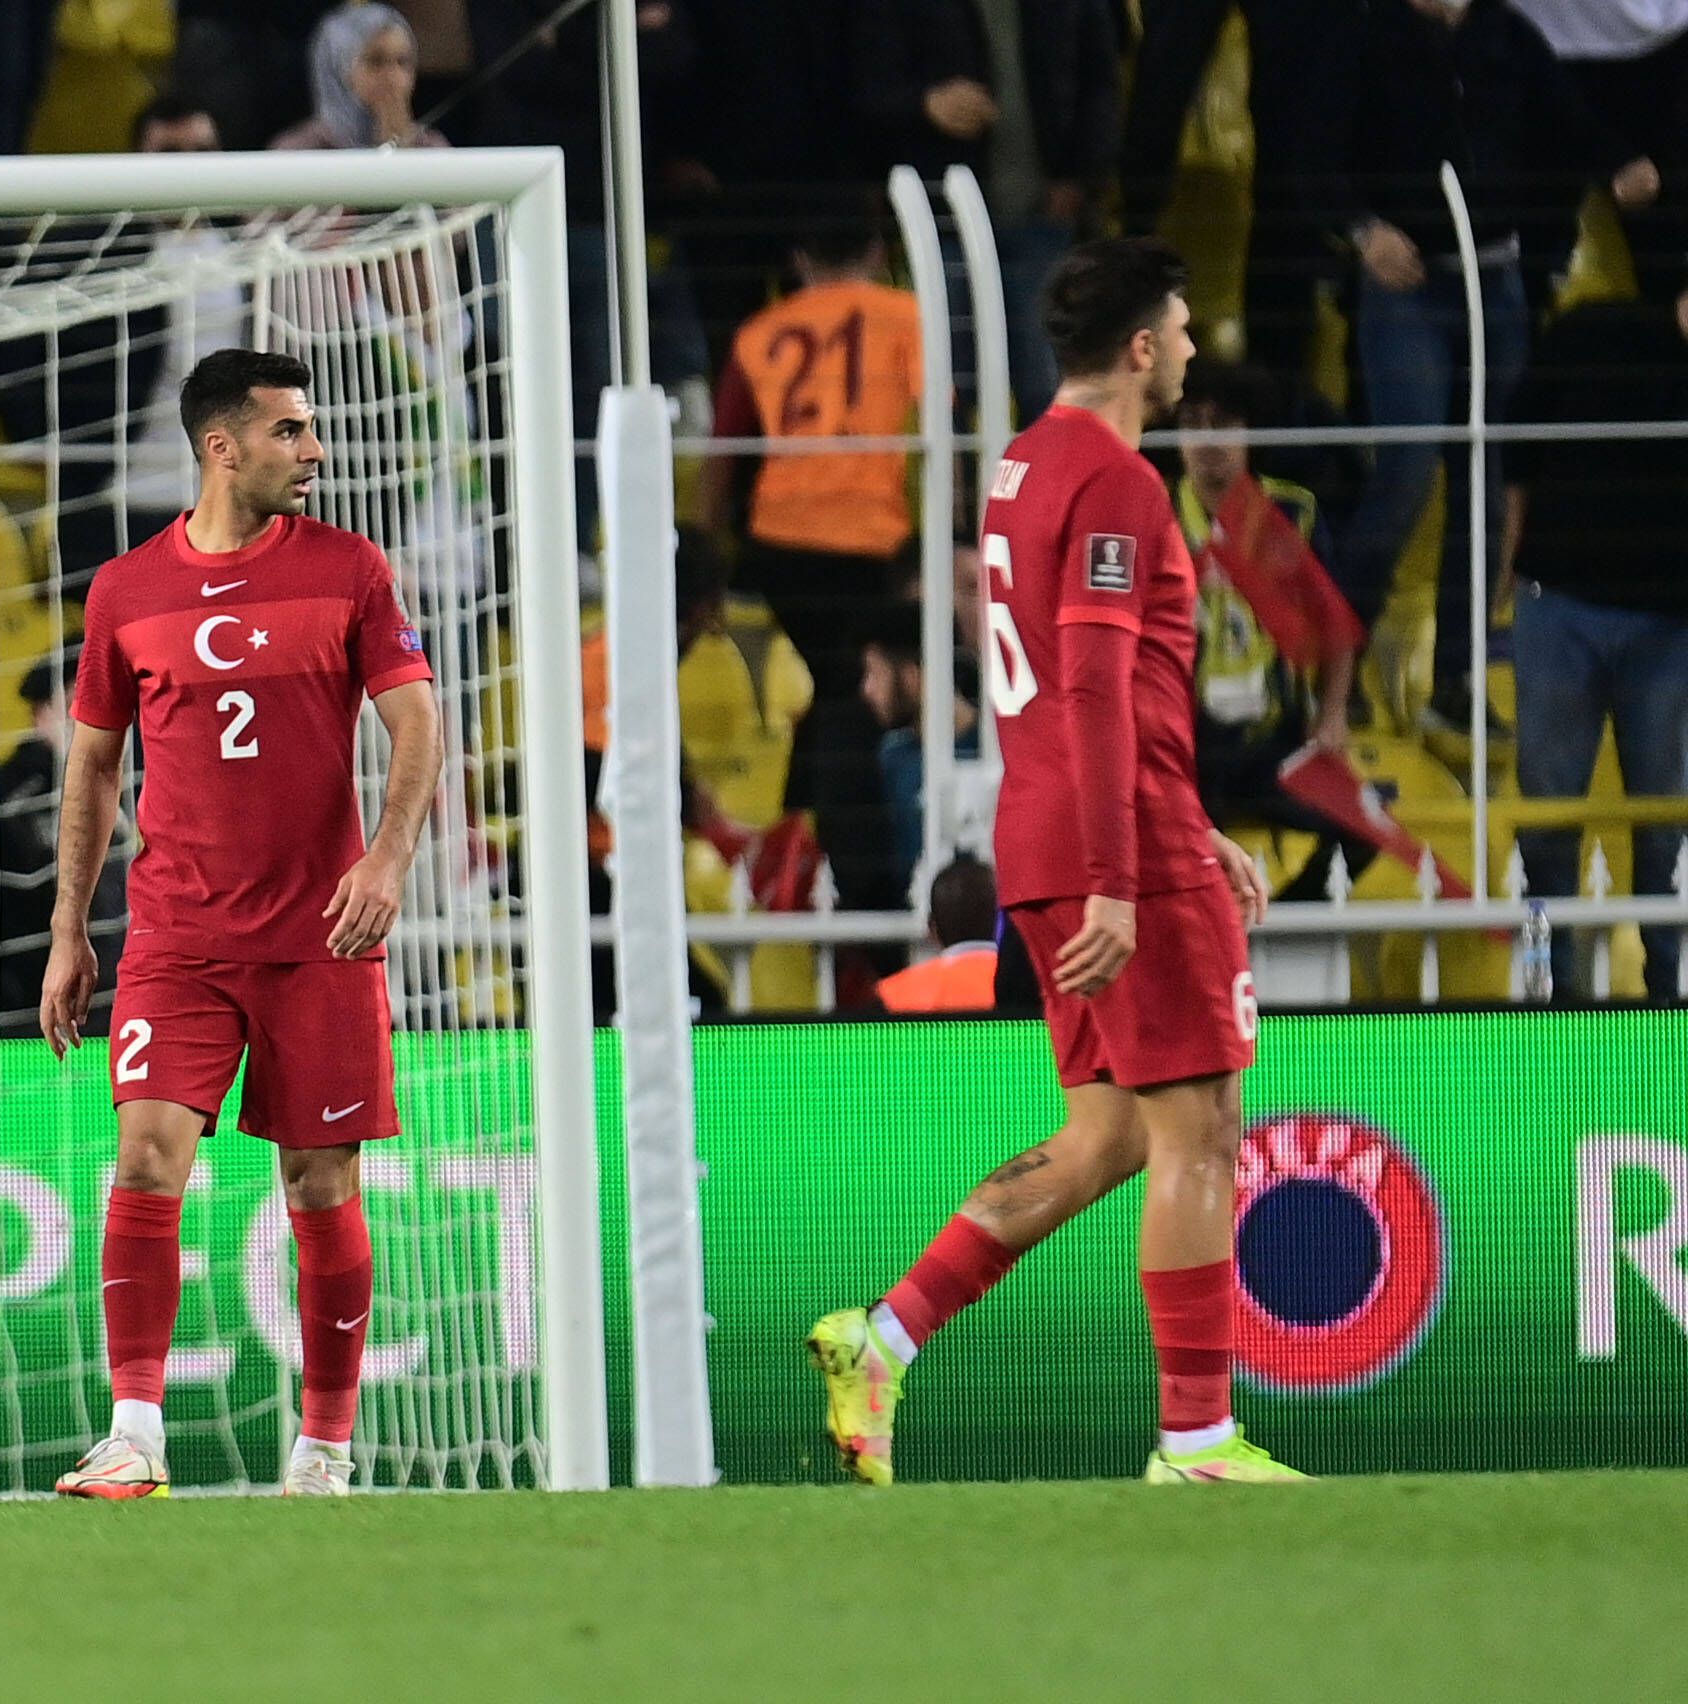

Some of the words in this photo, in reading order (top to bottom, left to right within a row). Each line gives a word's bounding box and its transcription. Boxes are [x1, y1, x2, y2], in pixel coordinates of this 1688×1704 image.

[766, 308, 865, 437] 21
[983, 532, 1039, 716] 6
[216, 690, 259, 760] 2
[1232, 969, 1258, 1041] 6
[116, 1018, 153, 1086] 2
